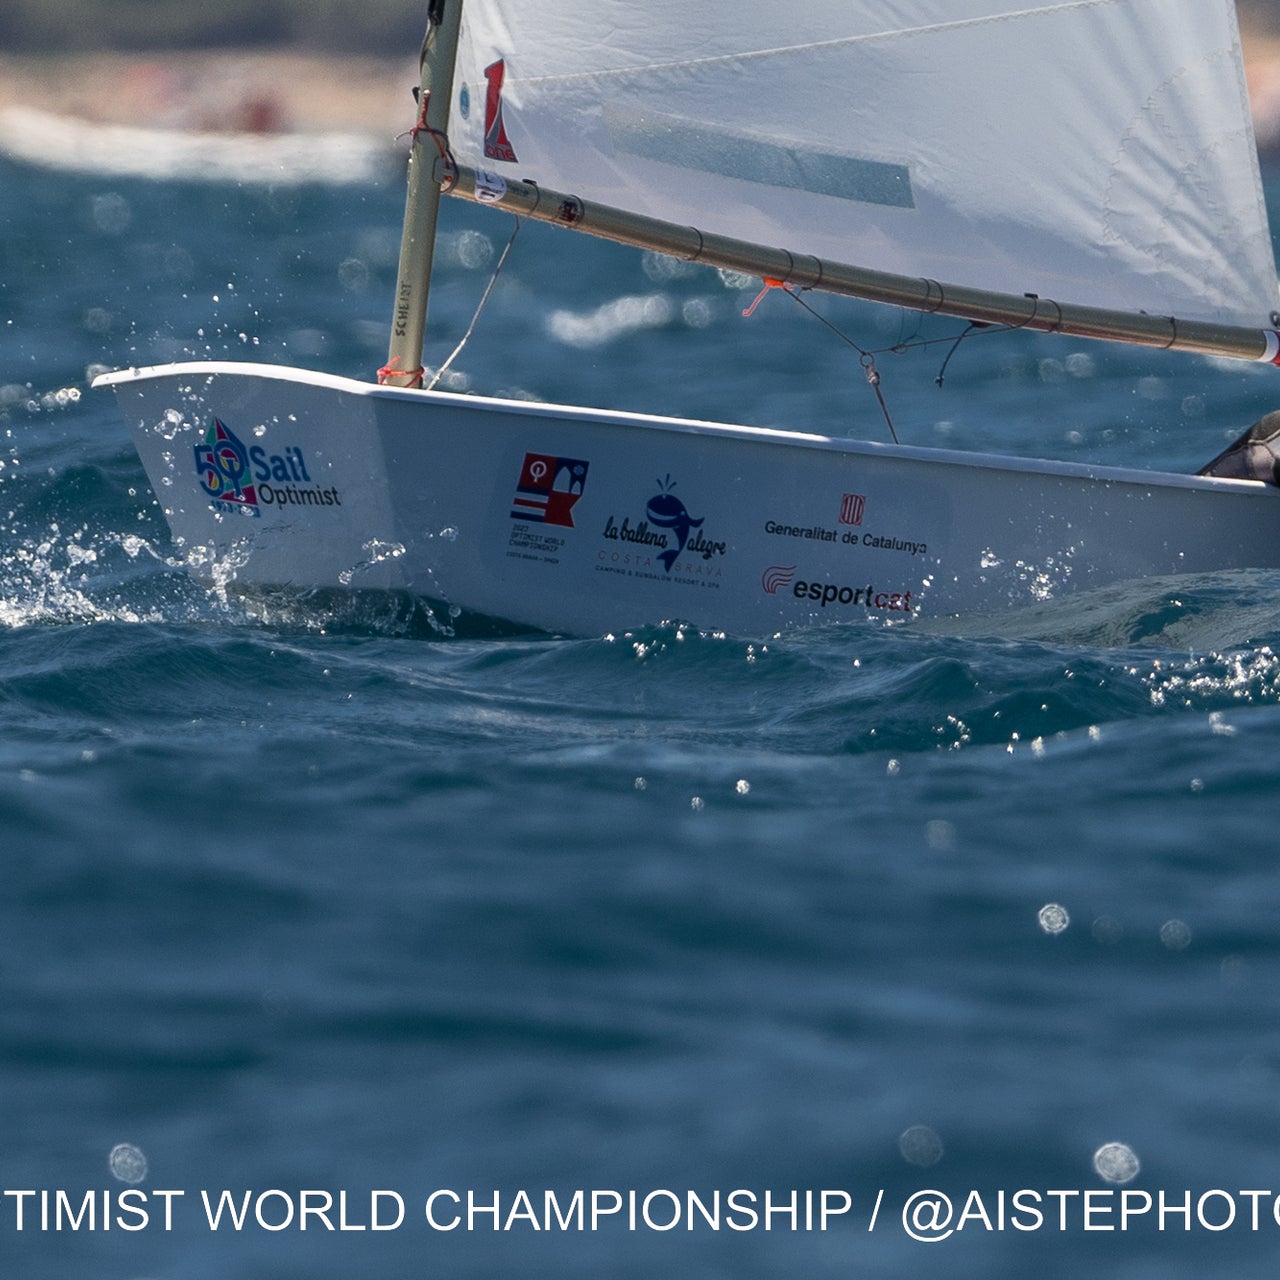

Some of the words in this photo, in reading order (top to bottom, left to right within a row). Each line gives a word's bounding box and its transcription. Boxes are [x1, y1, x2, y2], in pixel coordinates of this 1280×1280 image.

[249, 445, 311, 482] Sail
[258, 483, 342, 510] Optimist
[602, 516, 619, 540] la
[619, 517, 668, 549] ballena
[686, 528, 727, 561] alegre
[764, 520, 838, 543] Generalitat
[841, 531, 859, 545] de
[862, 533, 928, 557] Catalunya
[598, 550, 652, 567] COSTA
[674, 562, 723, 578] BRAVA
[792, 580, 913, 612] esportcat
